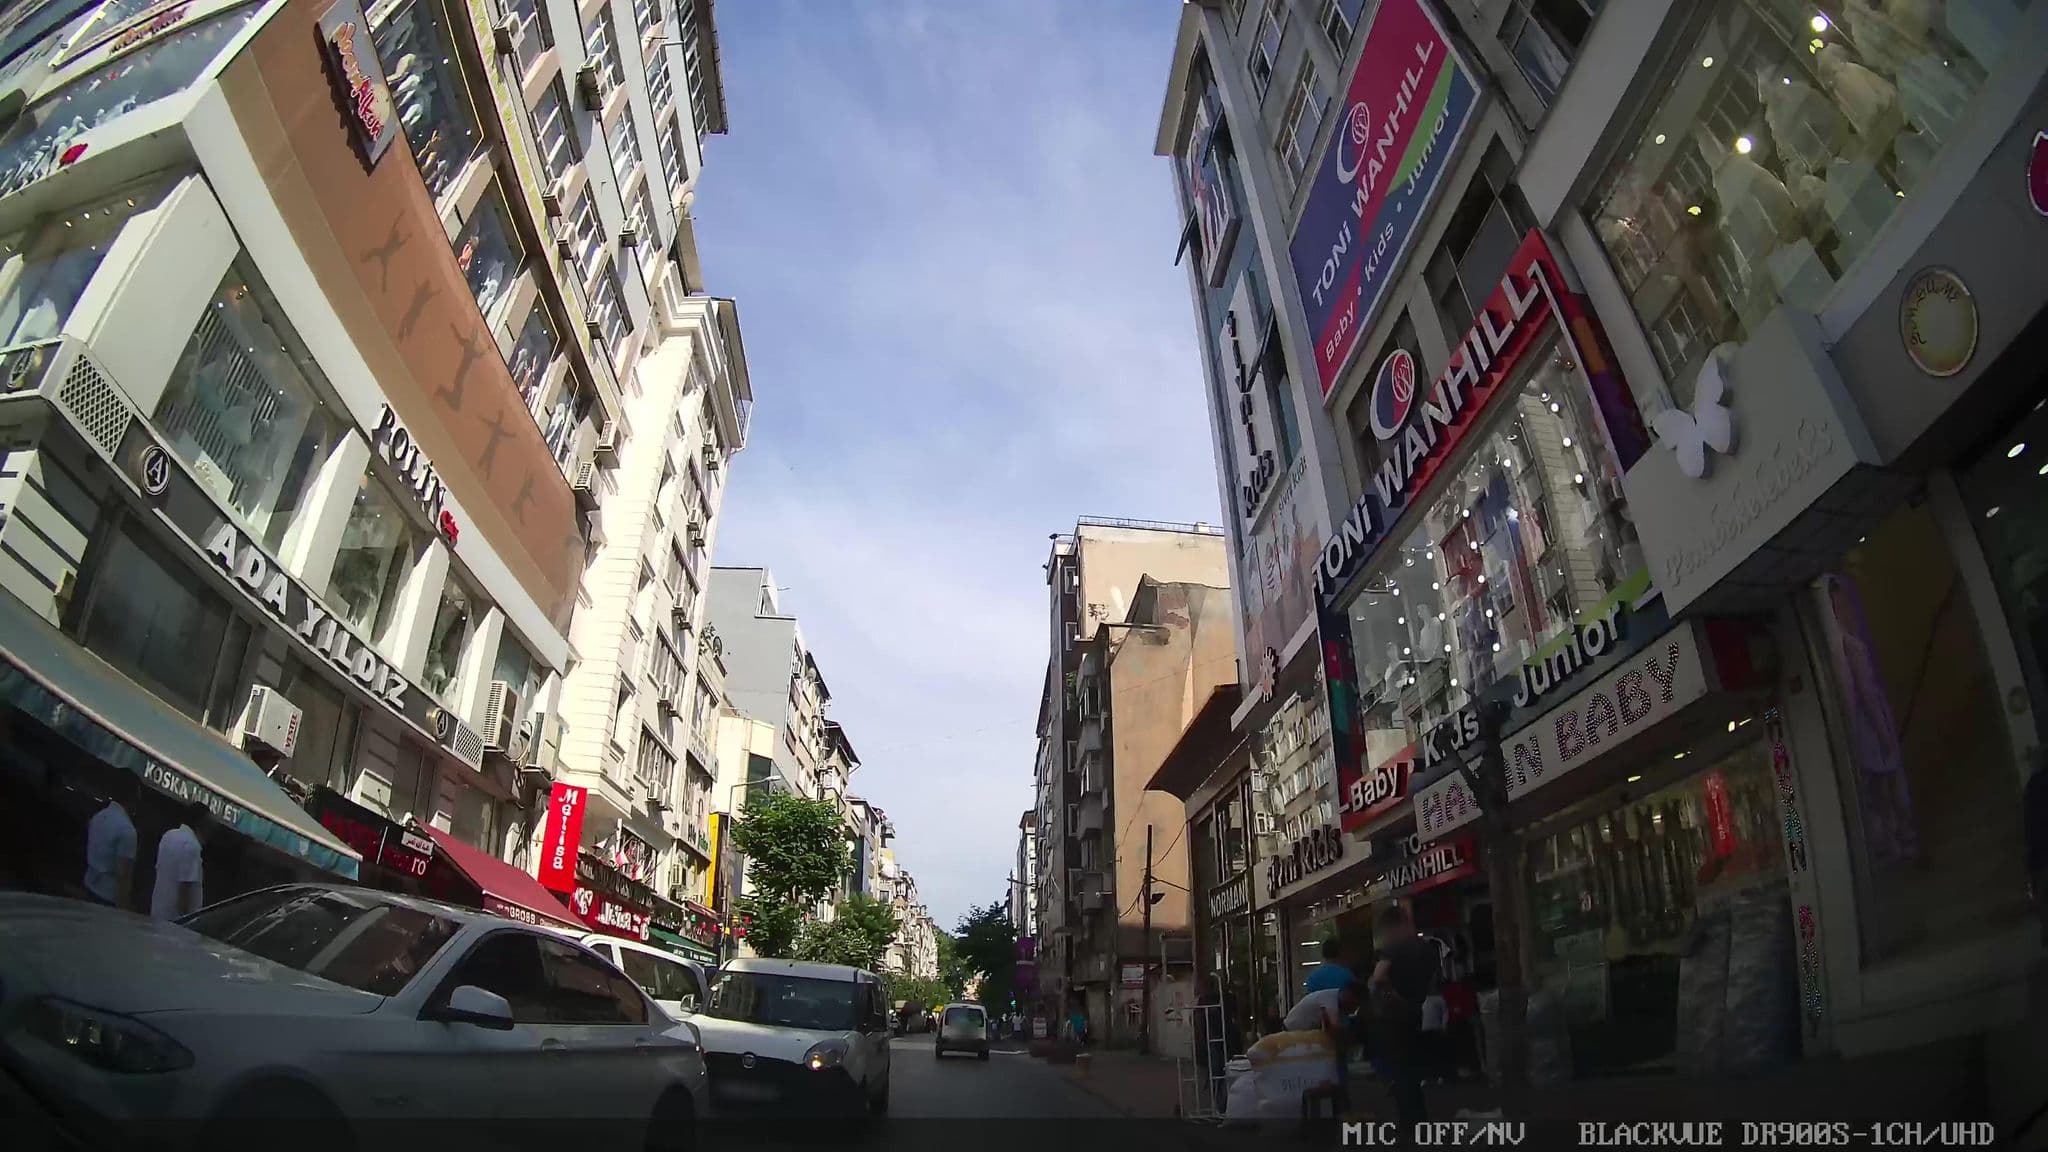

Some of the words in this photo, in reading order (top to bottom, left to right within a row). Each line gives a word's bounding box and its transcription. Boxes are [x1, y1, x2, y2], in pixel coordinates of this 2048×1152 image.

[1350, 39, 1434, 218] WANHILL
[1325, 302, 1355, 363] Baby
[1365, 222, 1394, 283] Kids
[1407, 98, 1450, 196] Junior
[1374, 273, 1541, 508] WANHILL
[143, 760, 188, 800] KOSKA
[1350, 763, 1399, 809] Baby
[1513, 602, 1620, 707] Junior
[1555, 641, 1680, 762] BABY
[1385, 845, 1465, 891] WANHILL
